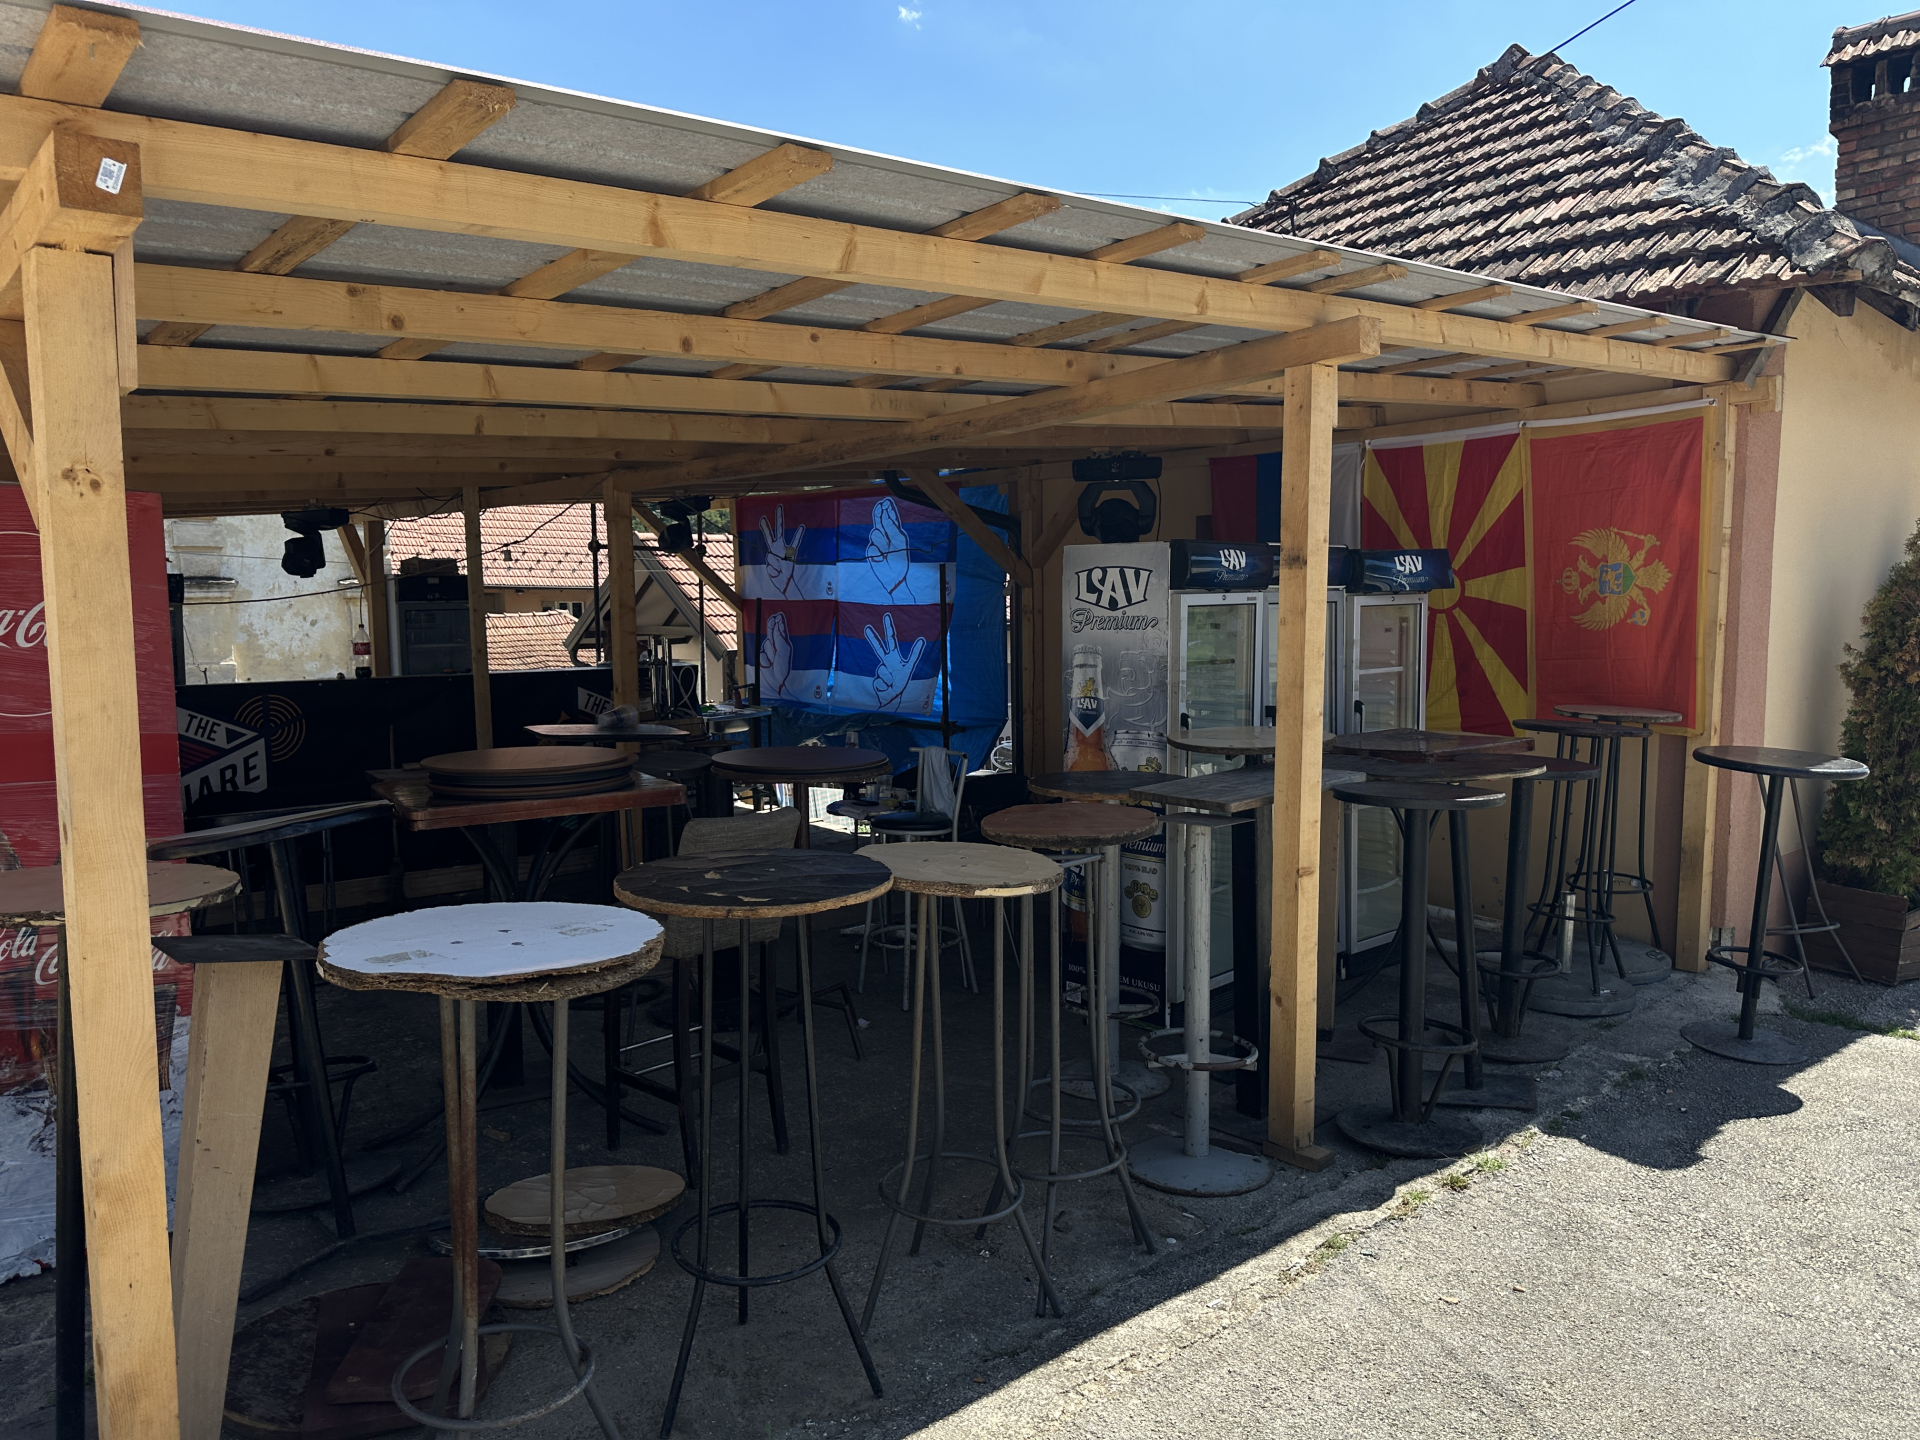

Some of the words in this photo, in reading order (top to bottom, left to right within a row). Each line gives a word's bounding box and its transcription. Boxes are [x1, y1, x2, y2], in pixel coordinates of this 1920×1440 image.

[1219, 549, 1246, 570] LAV
[1394, 555, 1422, 574] LAV
[1076, 567, 1153, 610] LAV
[1072, 609, 1158, 633] Premium
[584, 693, 610, 714] THE
[1077, 698, 1098, 709] LAV
[185, 713, 221, 743] THE
[1132, 979, 1161, 992] UKUSU
